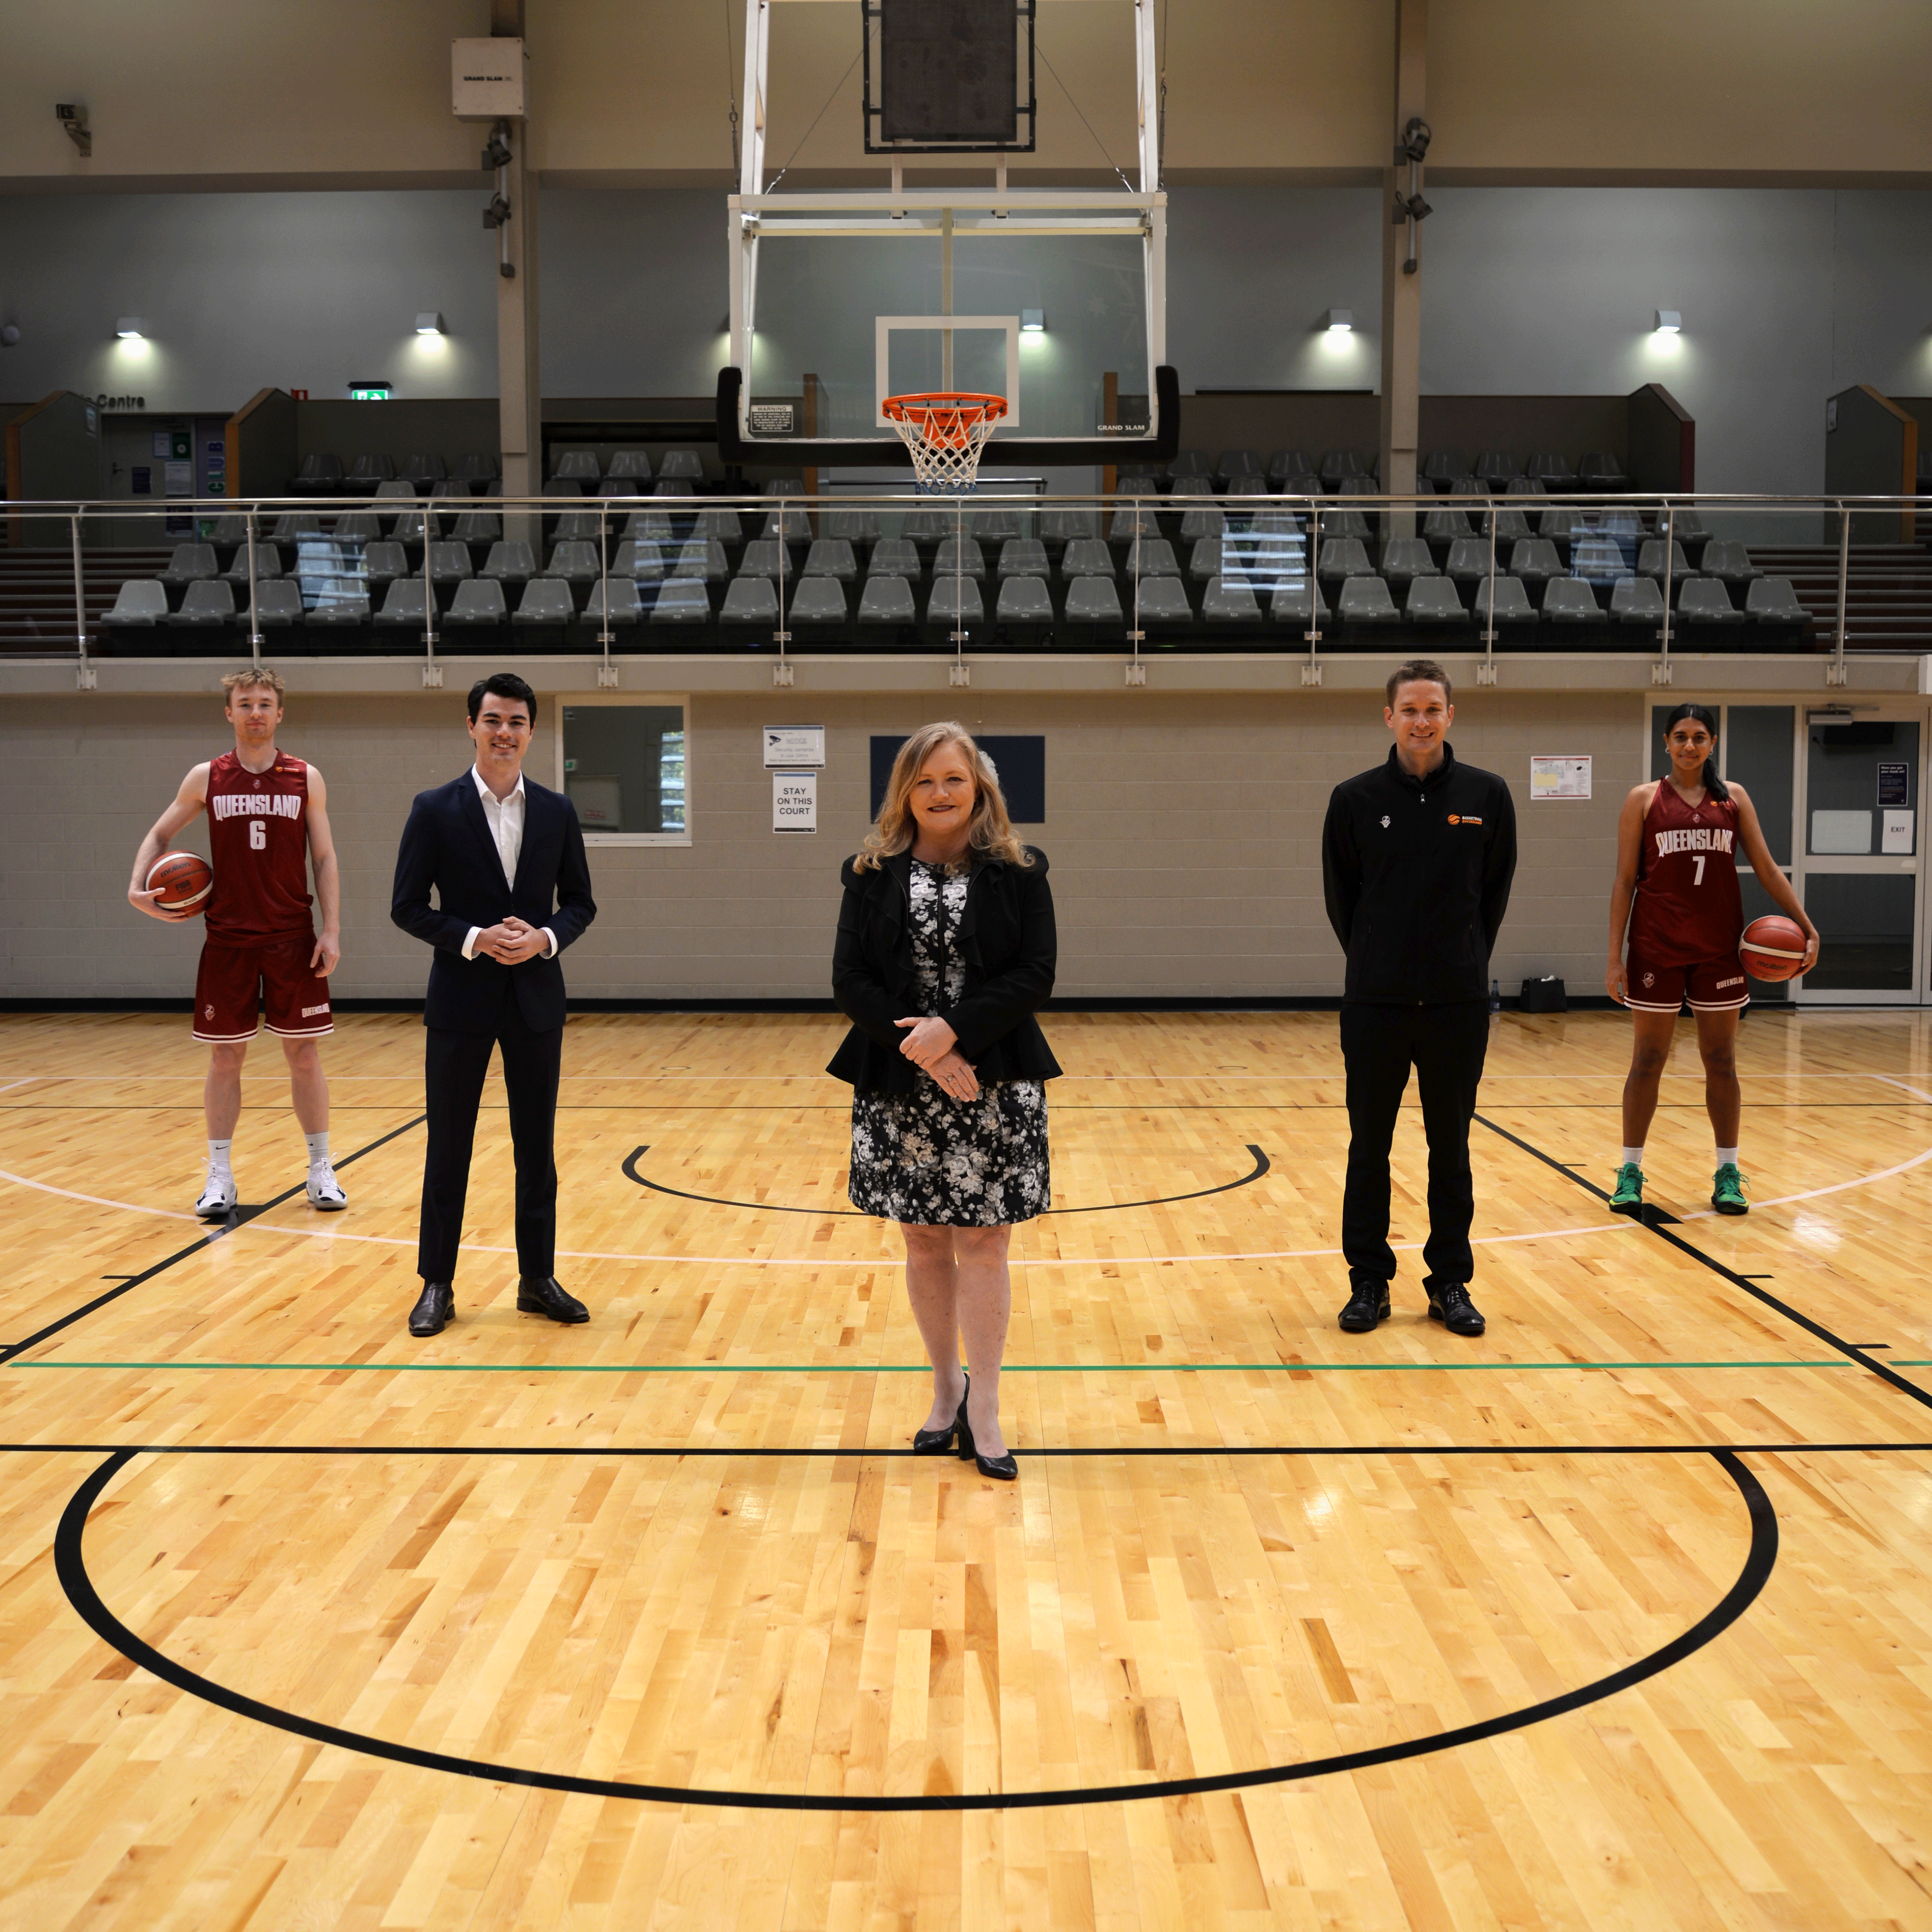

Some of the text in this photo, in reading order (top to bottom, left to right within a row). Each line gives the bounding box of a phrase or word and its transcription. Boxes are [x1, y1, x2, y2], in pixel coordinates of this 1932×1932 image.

[97, 394, 144, 407] Centre
[213, 794, 302, 821] QUEENSLAND
[250, 821, 266, 850] 6
[161, 863, 191, 878] molten
[1692, 855, 1705, 885] 7
[1756, 961, 1787, 971] molten
